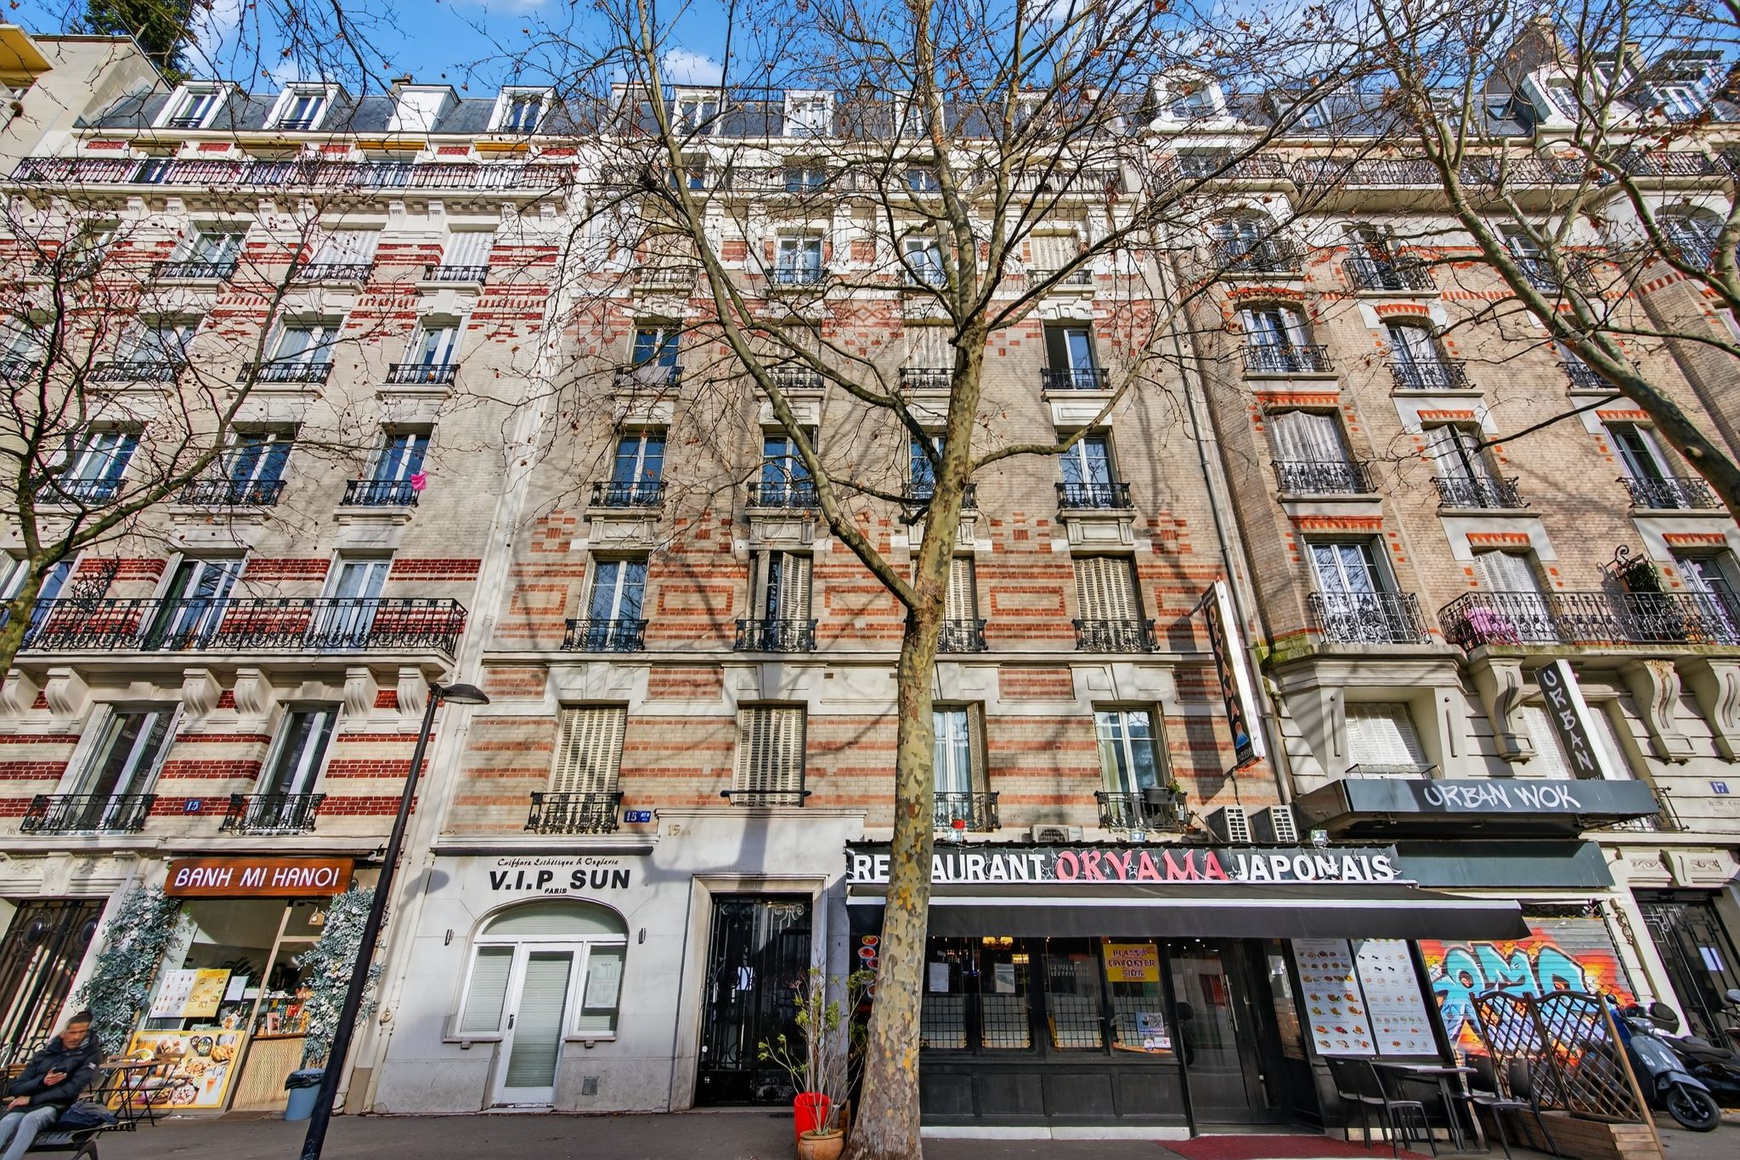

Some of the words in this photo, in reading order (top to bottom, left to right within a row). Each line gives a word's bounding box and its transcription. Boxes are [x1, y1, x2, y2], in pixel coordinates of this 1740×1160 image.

[1543, 669, 1594, 771] URBAN
[1424, 783, 1512, 808] URBAN
[1513, 785, 1581, 808] WOK
[1712, 782, 1725, 793] 17
[853, 854, 1045, 881] REAURANT
[1055, 849, 1230, 881] OKYAMA
[1236, 854, 1395, 881] JAPONAIS
[175, 867, 233, 887] BANH
[239, 867, 267, 887] MI
[272, 867, 339, 887] HANOI
[489, 870, 553, 891] V.I.P
[570, 869, 630, 890] SUN
